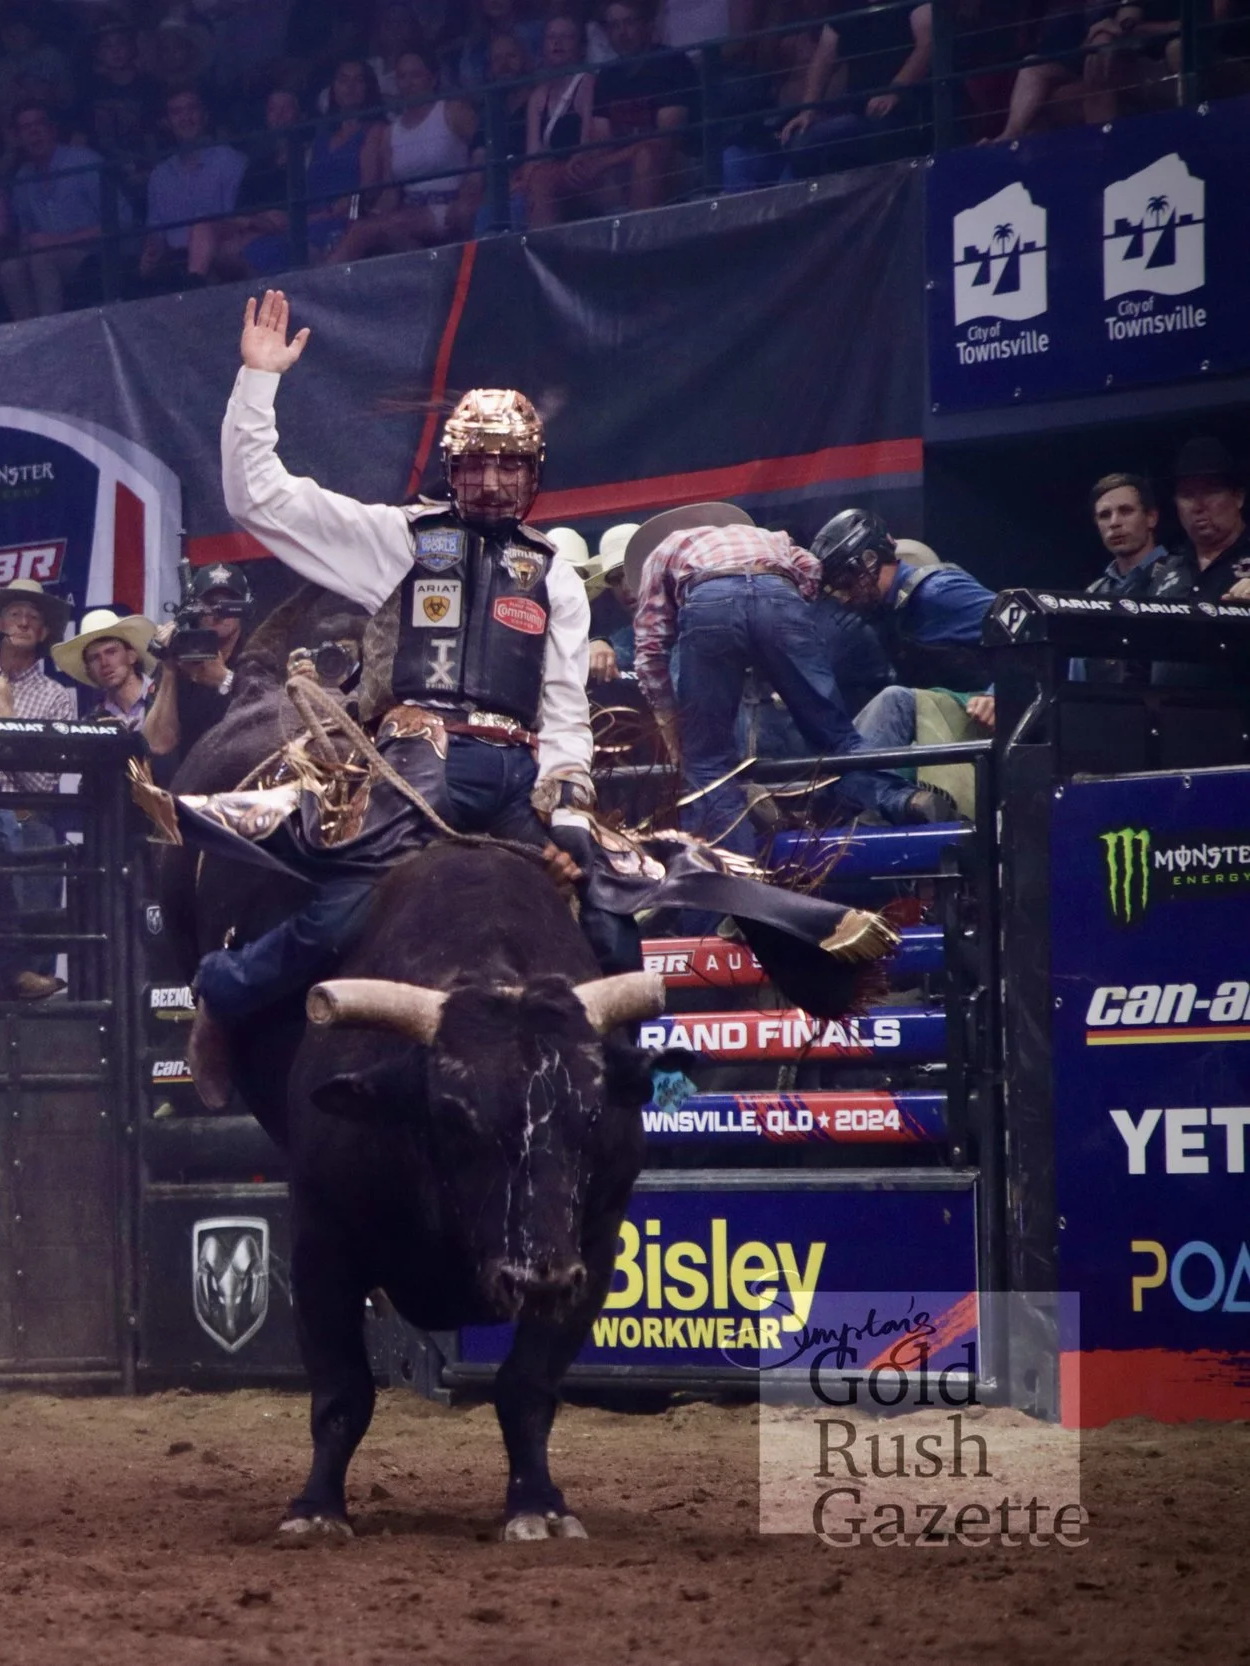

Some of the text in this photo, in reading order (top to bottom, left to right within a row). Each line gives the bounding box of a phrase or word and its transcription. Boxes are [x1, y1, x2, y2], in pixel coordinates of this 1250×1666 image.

[1117, 297, 1154, 318] City of
[967, 322, 1002, 342] City of
[1105, 306, 1207, 341] Townsville
[956, 331, 1049, 366] Townsville
[417, 584, 459, 593] ARIAT
[1059, 599, 1113, 611] ARIAT
[1140, 602, 1192, 614] ARIAT
[1219, 606, 1250, 616] ARI
[70, 725, 118, 735] ARIAT
[644, 955, 688, 973] BR
[1085, 981, 1250, 1026] can-a
[639, 1019, 901, 1050] RAND FINALS
[642, 1109, 900, 1135] WNSVILLE, QLD 2024
[603, 1218, 827, 1332] Bisley
[593, 1316, 783, 1349] WORKWEAR
